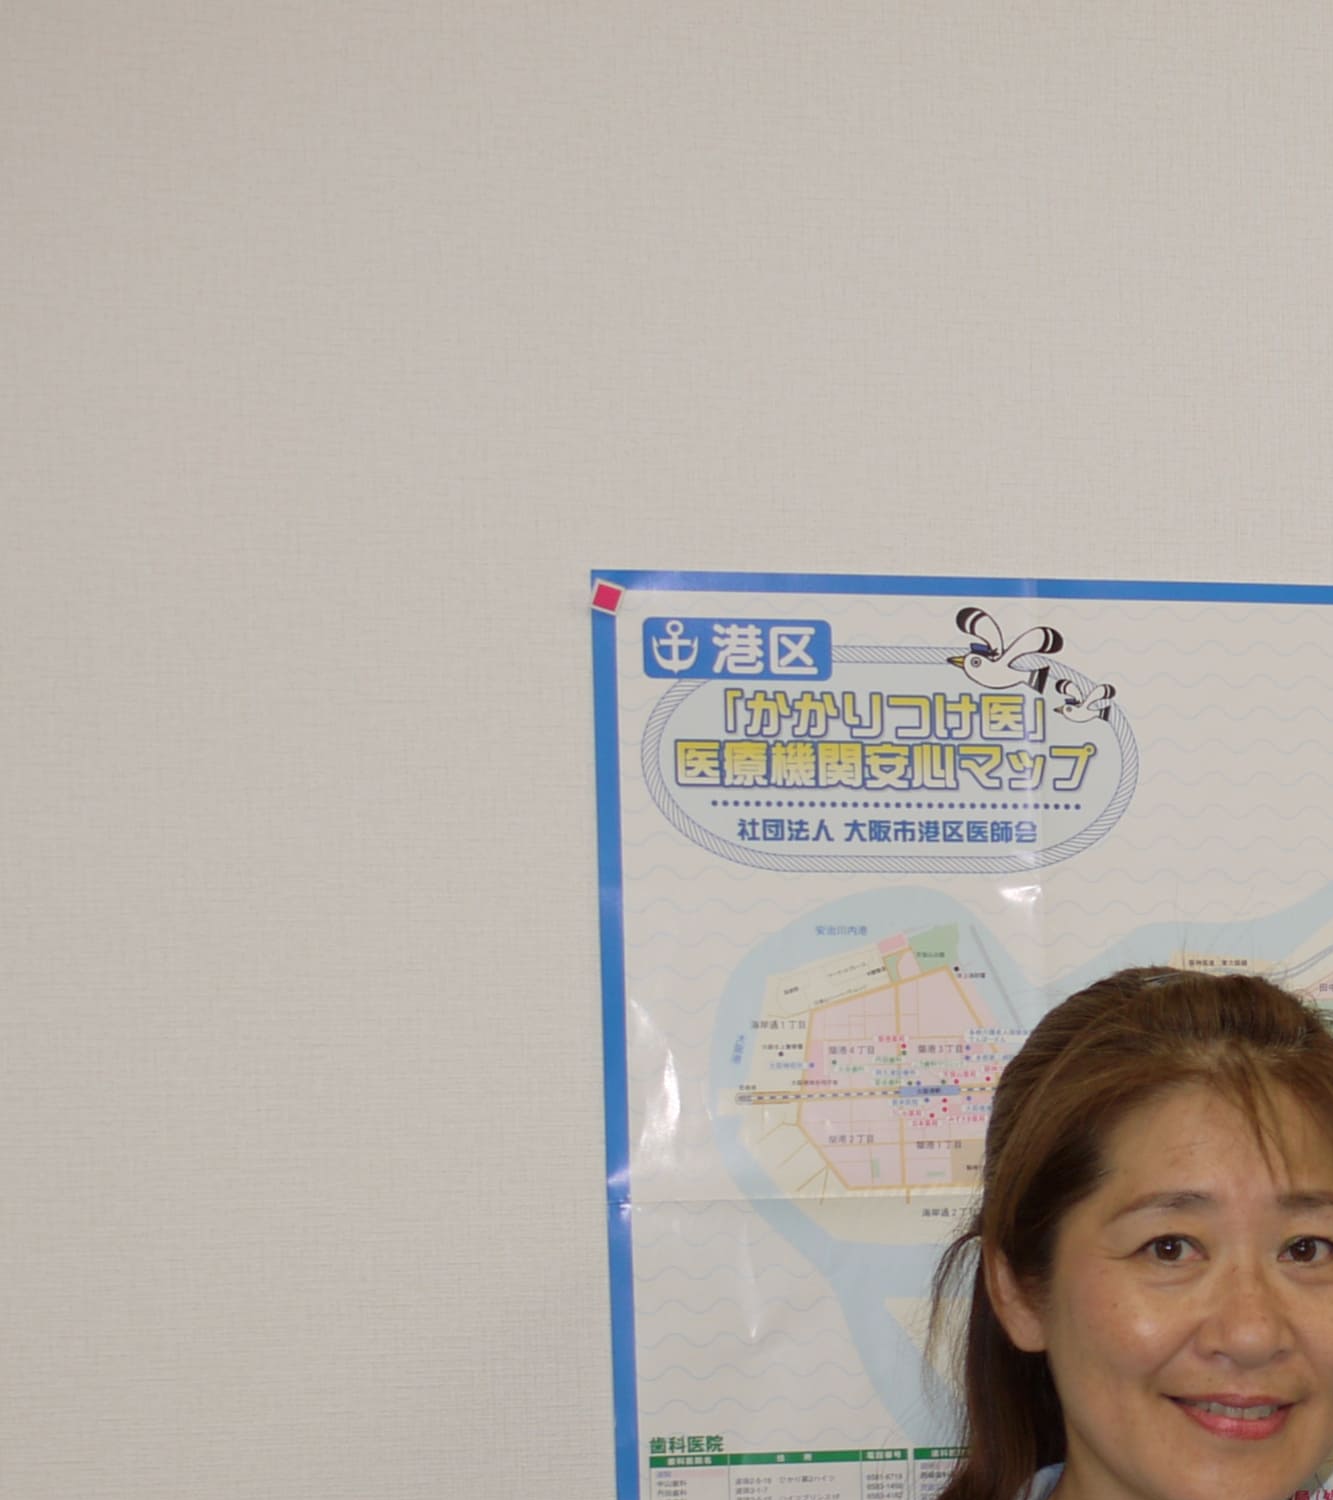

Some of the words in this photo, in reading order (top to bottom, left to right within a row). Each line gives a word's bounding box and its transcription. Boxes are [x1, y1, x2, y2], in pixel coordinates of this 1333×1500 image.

[711, 624, 819, 675] 港区
[721, 688, 1047, 743] 「かかりつけ医」
[673, 739, 1098, 792] 医療機関安心マップ
[736, 818, 836, 843] 社団法人
[844, 819, 1038, 844] 大阪市港区医師会
[649, 1435, 724, 1454] 歯科医院
